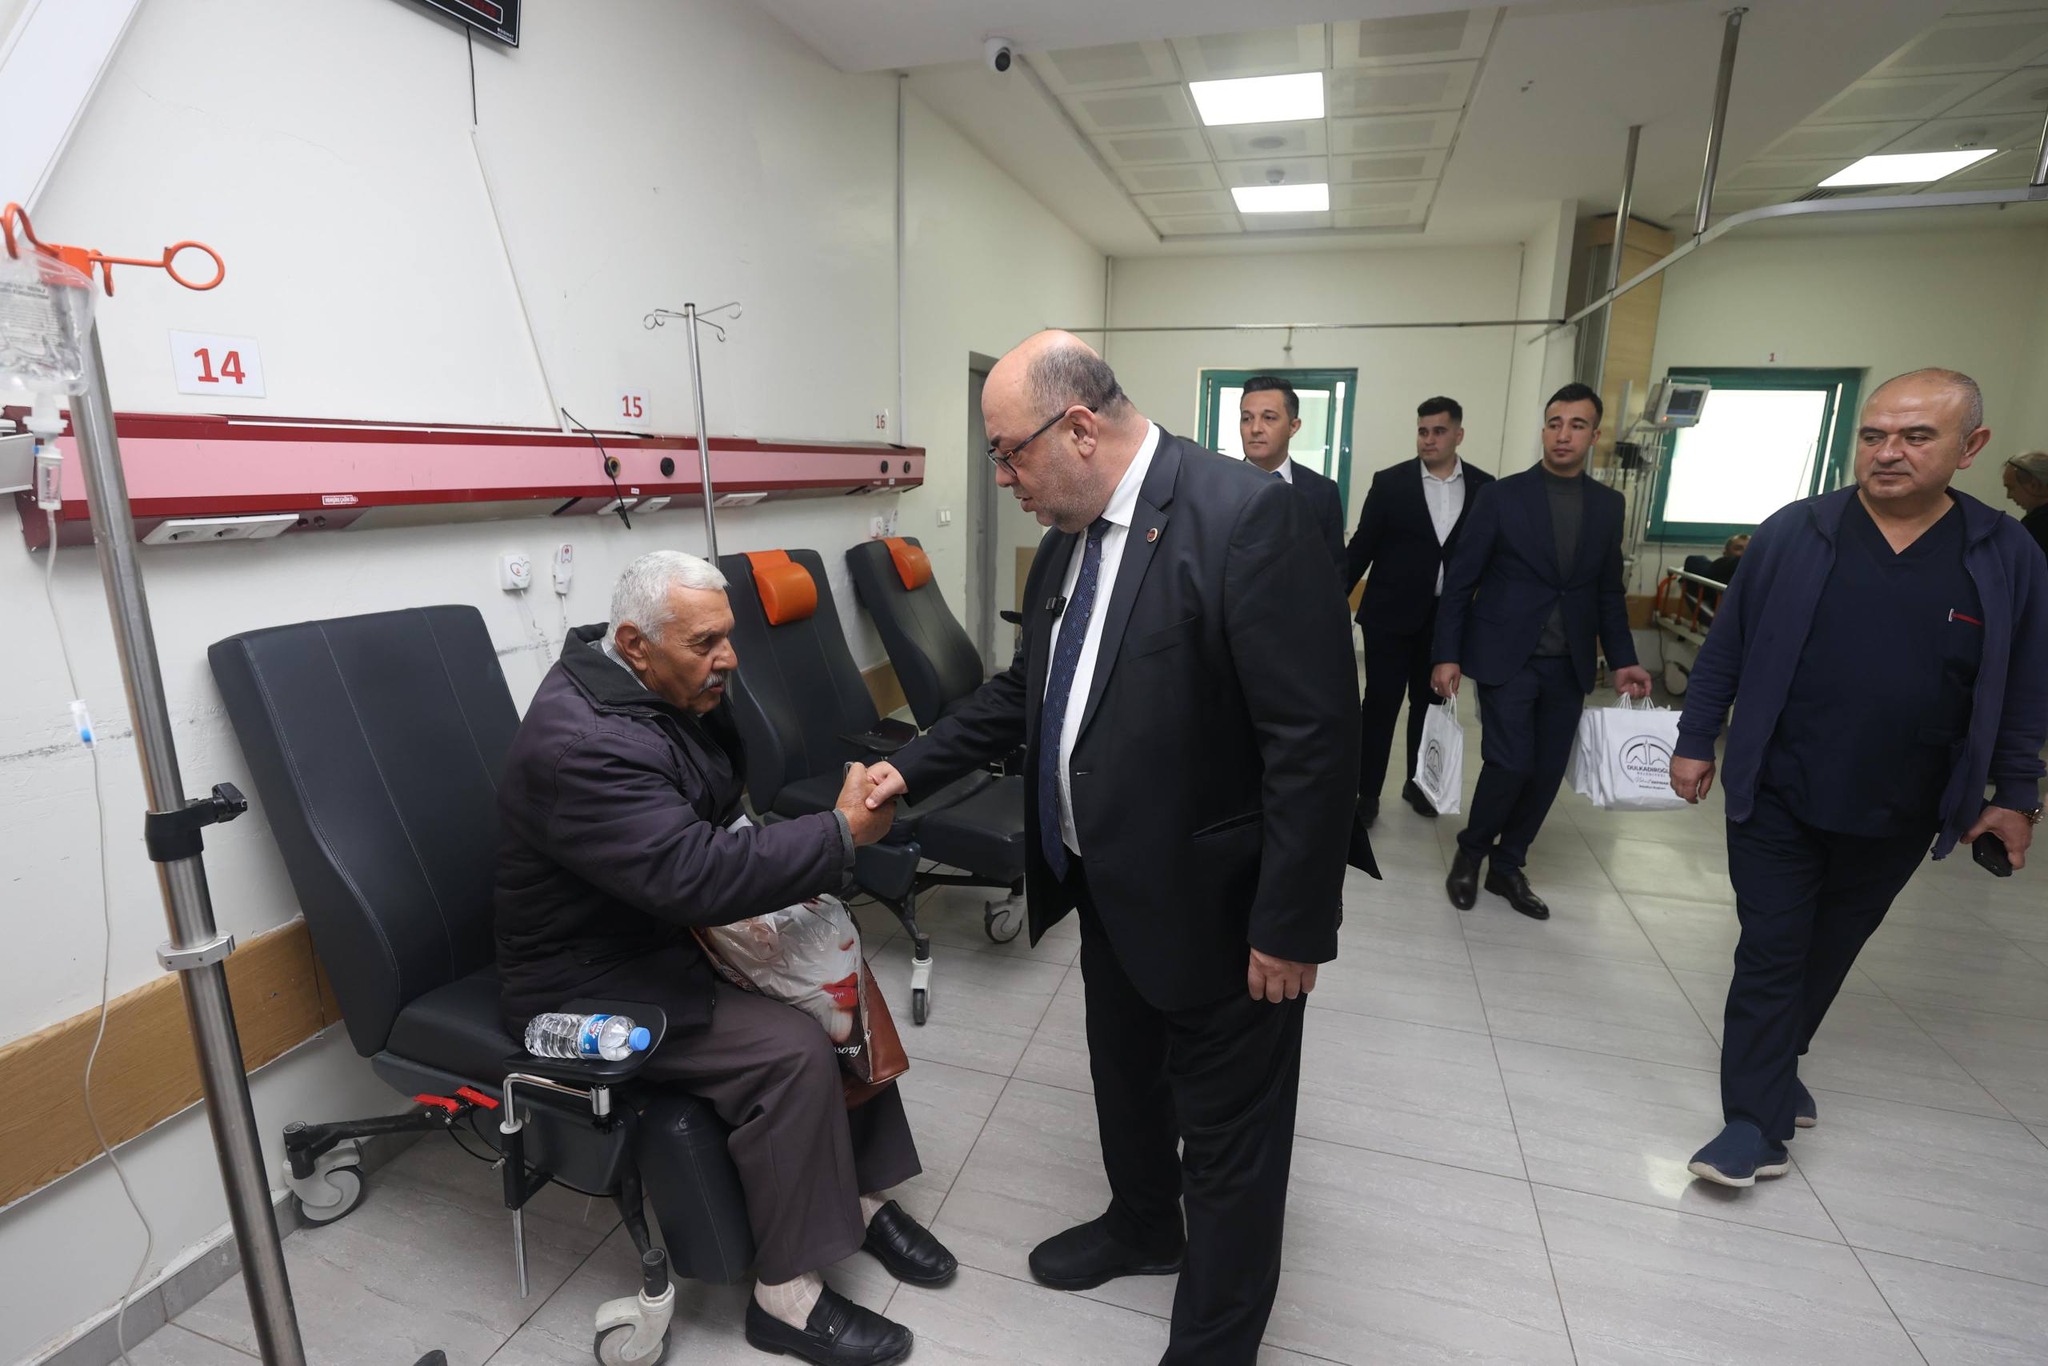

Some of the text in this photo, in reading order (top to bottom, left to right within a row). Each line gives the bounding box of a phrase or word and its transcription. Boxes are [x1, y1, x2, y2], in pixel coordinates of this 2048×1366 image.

[194, 348, 246, 384] 14
[622, 395, 643, 418] 15
[876, 414, 886, 429] 16
